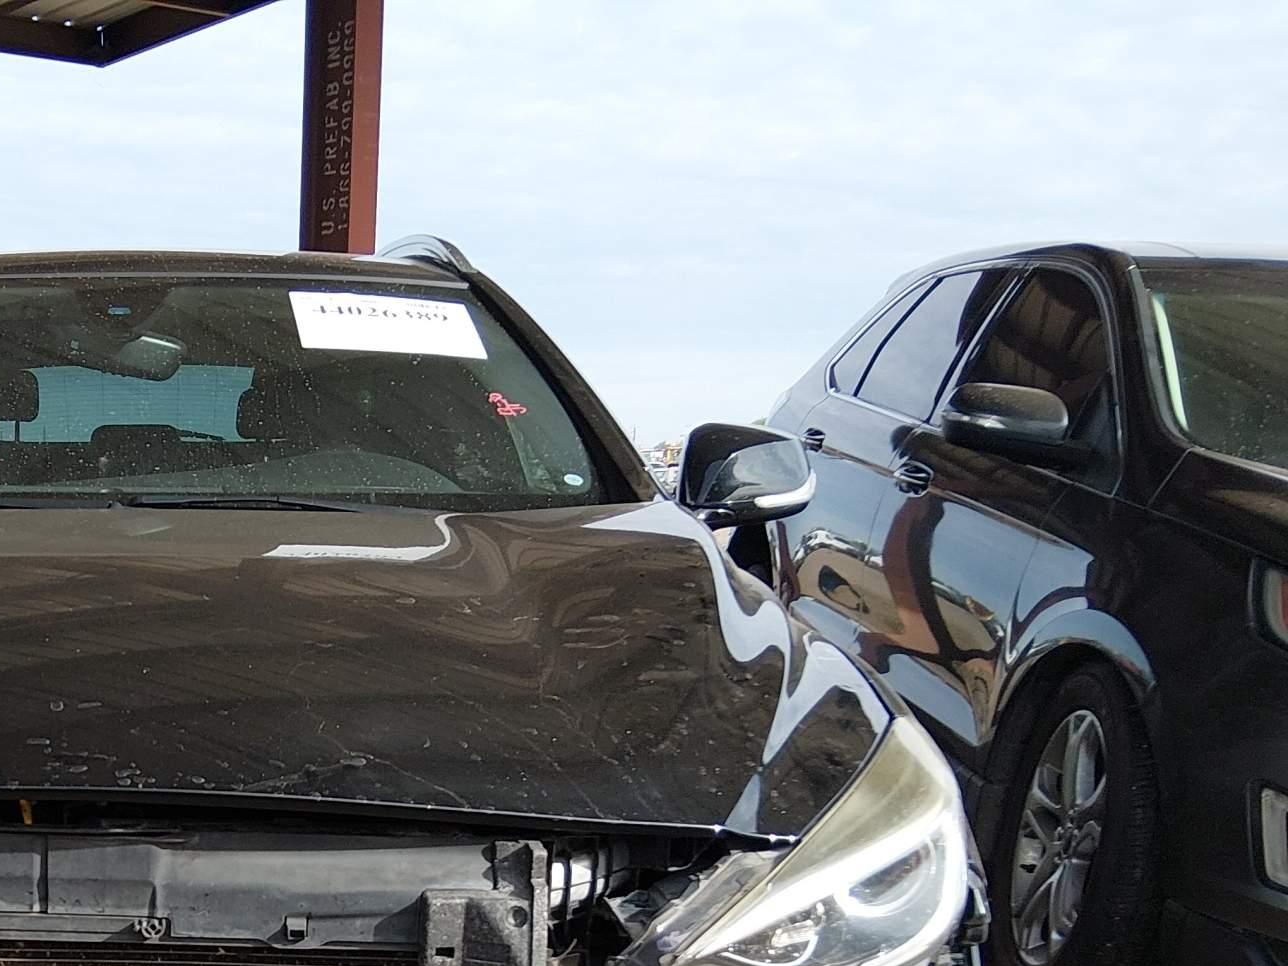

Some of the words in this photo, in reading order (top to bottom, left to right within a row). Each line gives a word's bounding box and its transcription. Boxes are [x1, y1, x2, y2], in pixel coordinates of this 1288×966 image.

[327, 22, 342, 68] INC.
[324, 82, 340, 176] PREFAB
[321, 190, 336, 236] U.S.
